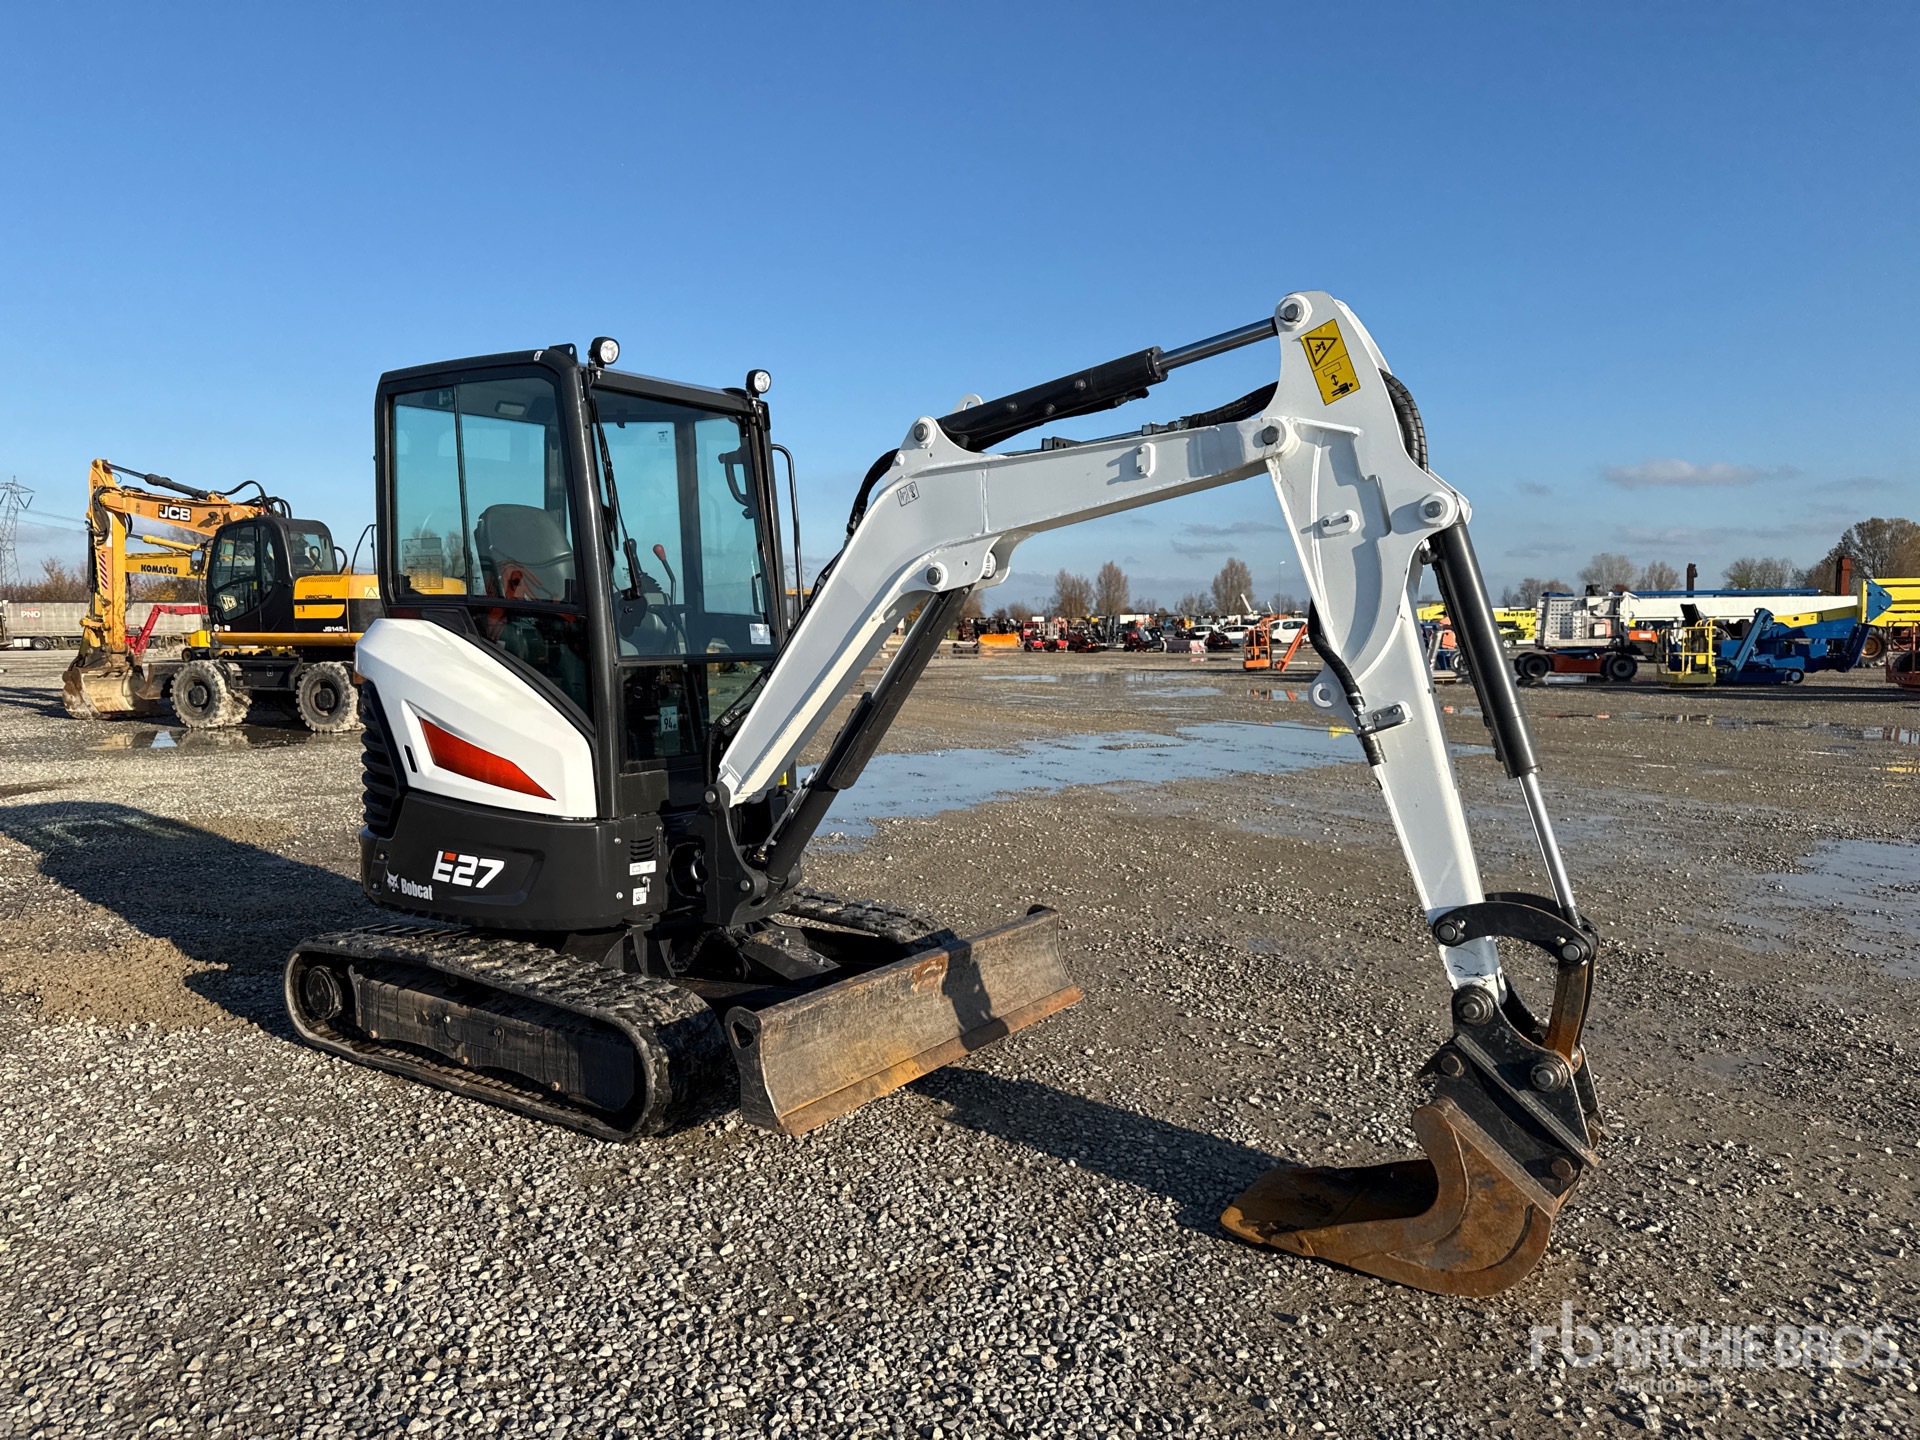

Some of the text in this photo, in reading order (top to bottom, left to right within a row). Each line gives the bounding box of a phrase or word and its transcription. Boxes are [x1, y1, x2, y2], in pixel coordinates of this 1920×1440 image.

[158, 505, 191, 522] JCB
[141, 563, 178, 575] KOMATSU
[21, 610, 41, 619] PNO
[432, 850, 505, 889] E27
[400, 877, 434, 901] Bobcat
